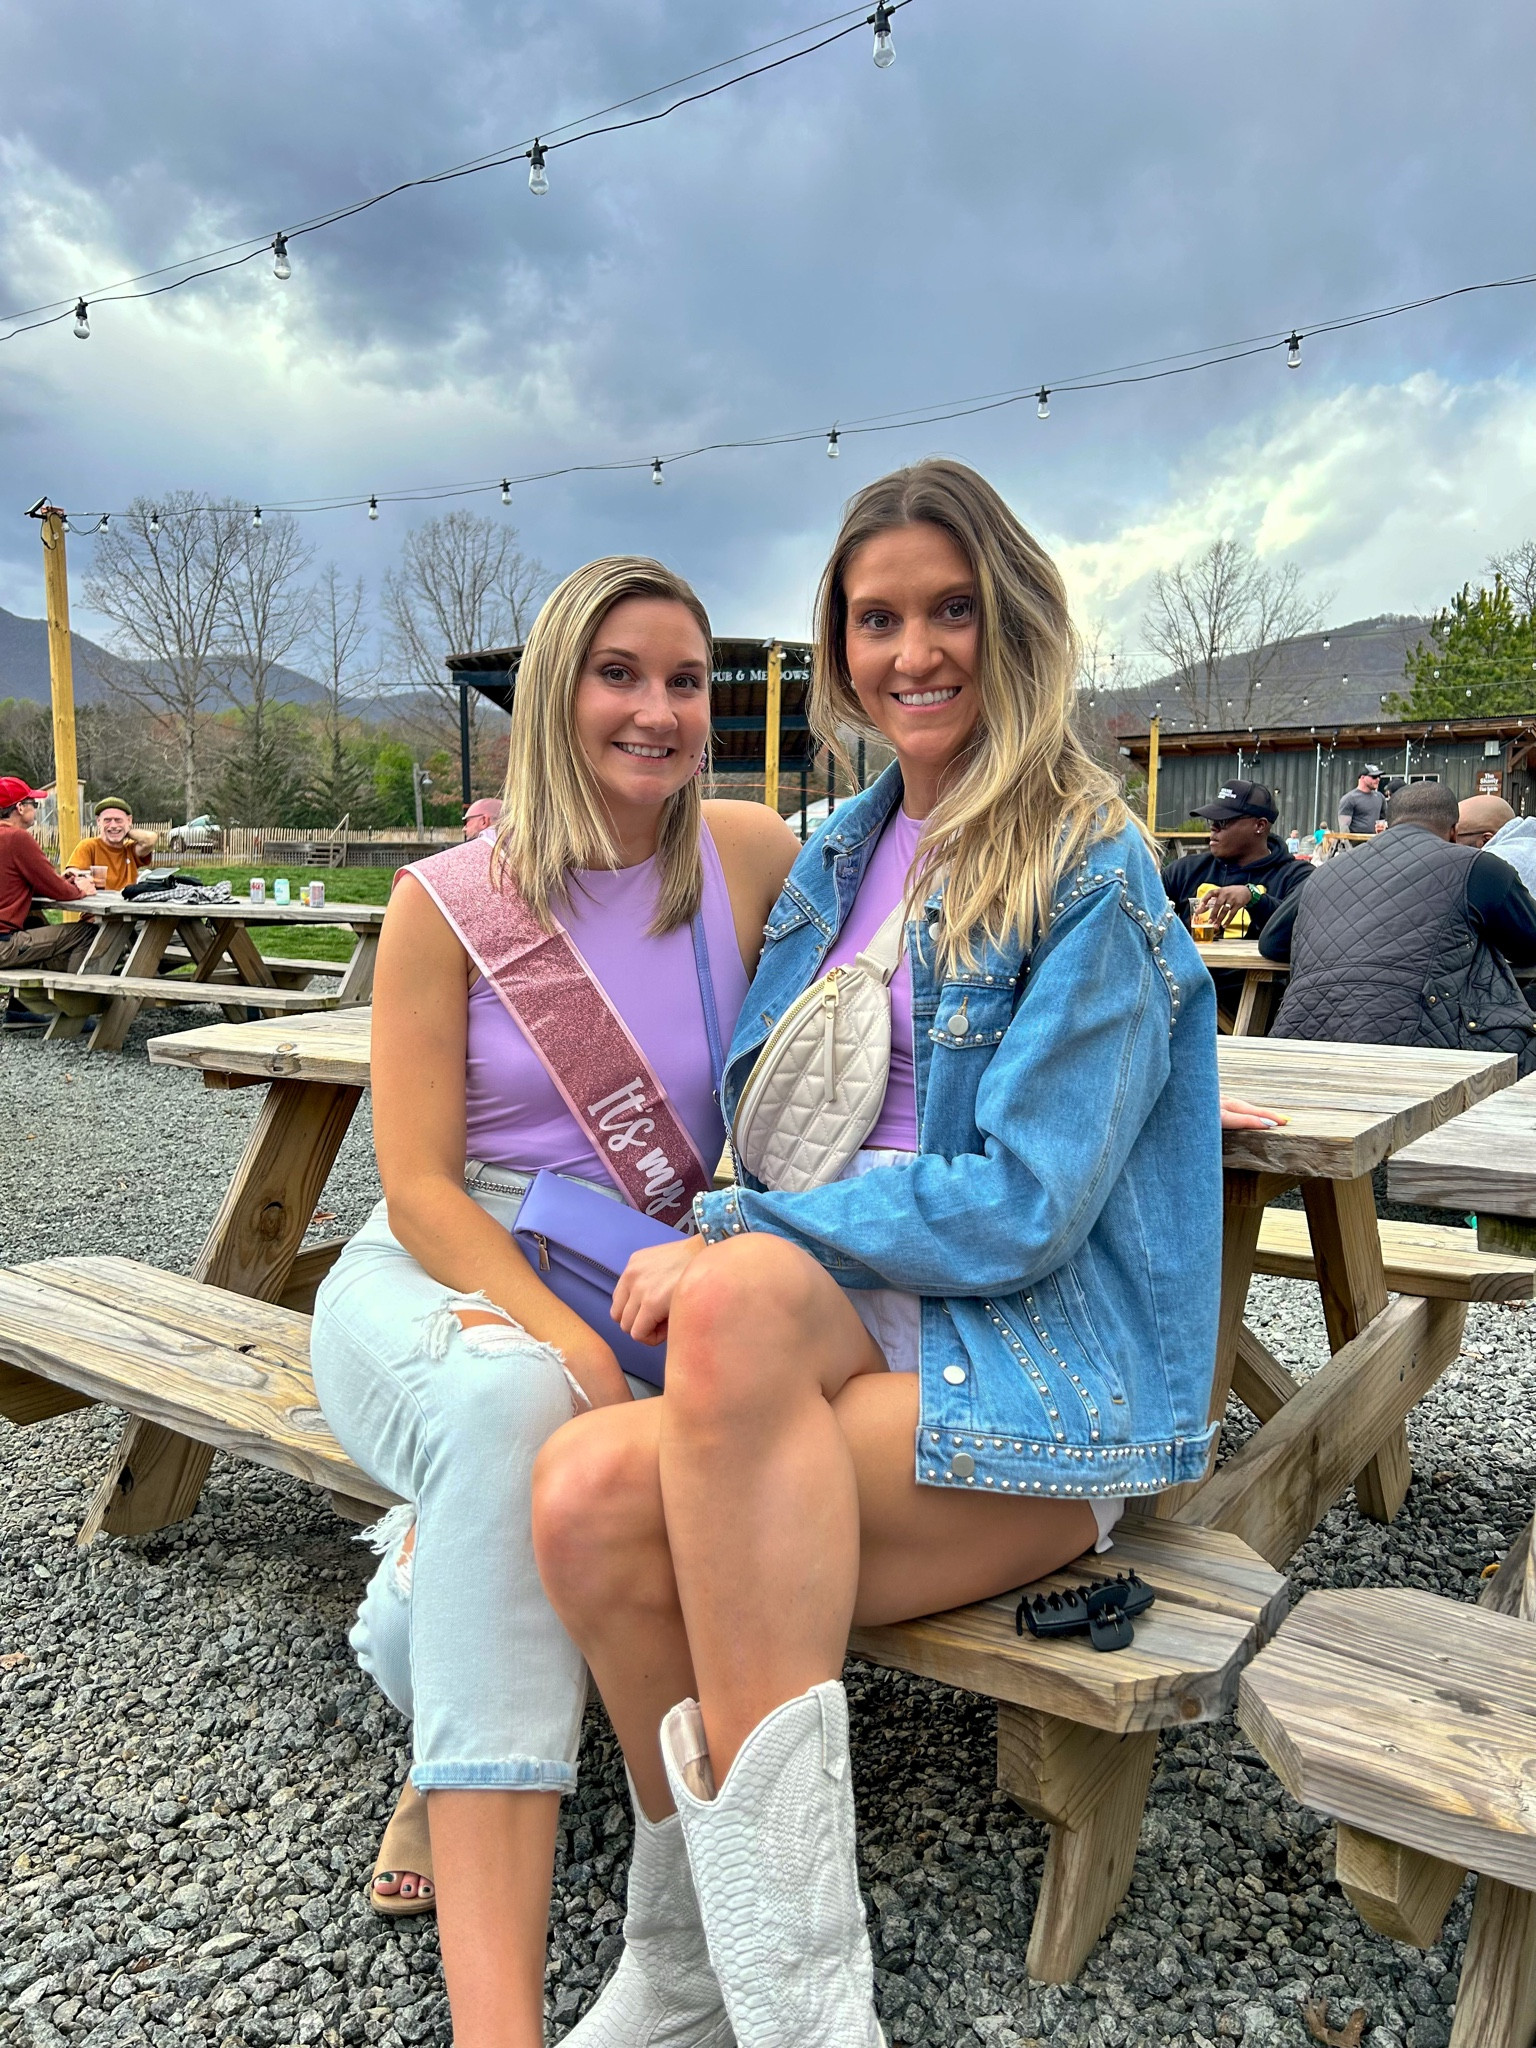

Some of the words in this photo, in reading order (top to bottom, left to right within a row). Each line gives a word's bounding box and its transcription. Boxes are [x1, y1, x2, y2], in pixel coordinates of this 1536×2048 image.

[711, 671, 733, 682] PUB
[736, 669, 745, 681] &
[750, 669, 810, 681] MEOWS
[587, 1076, 656, 1152] It's
[636, 1146, 686, 1216] my
